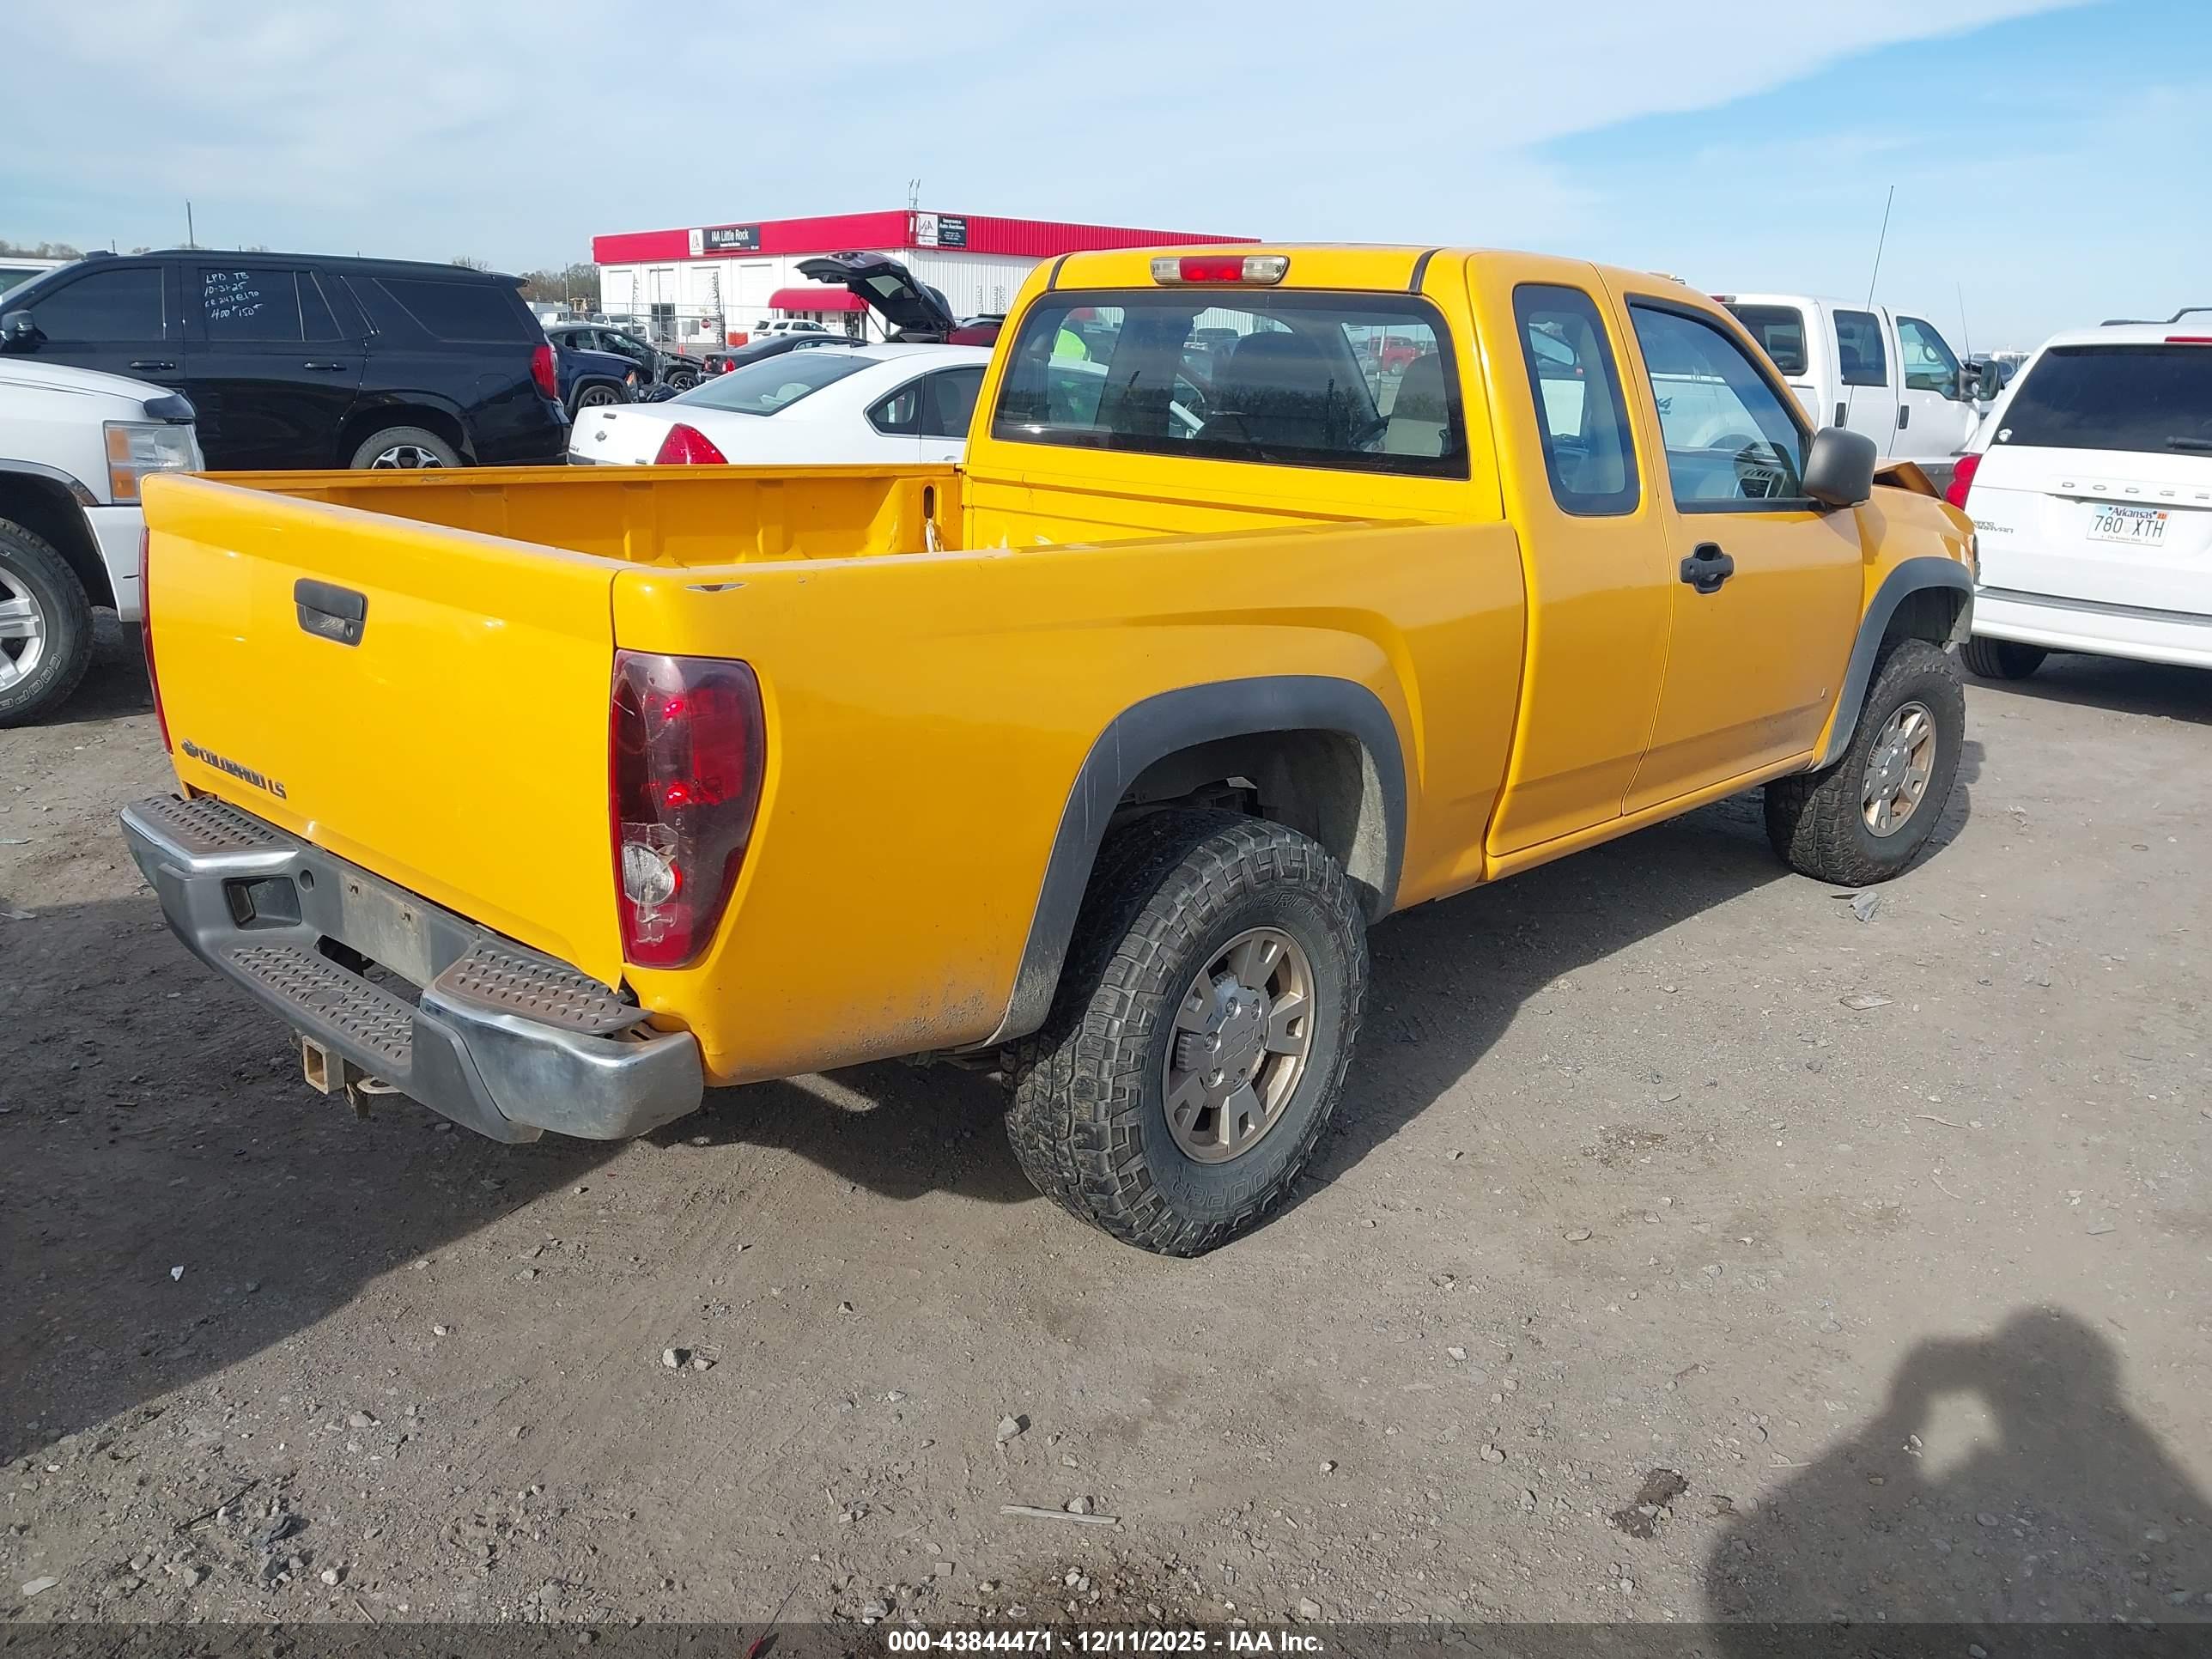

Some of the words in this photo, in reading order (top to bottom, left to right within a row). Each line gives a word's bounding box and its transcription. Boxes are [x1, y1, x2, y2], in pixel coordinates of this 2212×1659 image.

[711, 230, 720, 242] IAA
[720, 229, 735, 242] Little
[735, 228, 750, 240] Rock
[2062, 481, 2211, 500] DODGE
[2110, 507, 2154, 520] Arkansas
[2094, 514, 2124, 533] 780
[2132, 519, 2166, 538] XTH
[267, 777, 287, 800] LS
